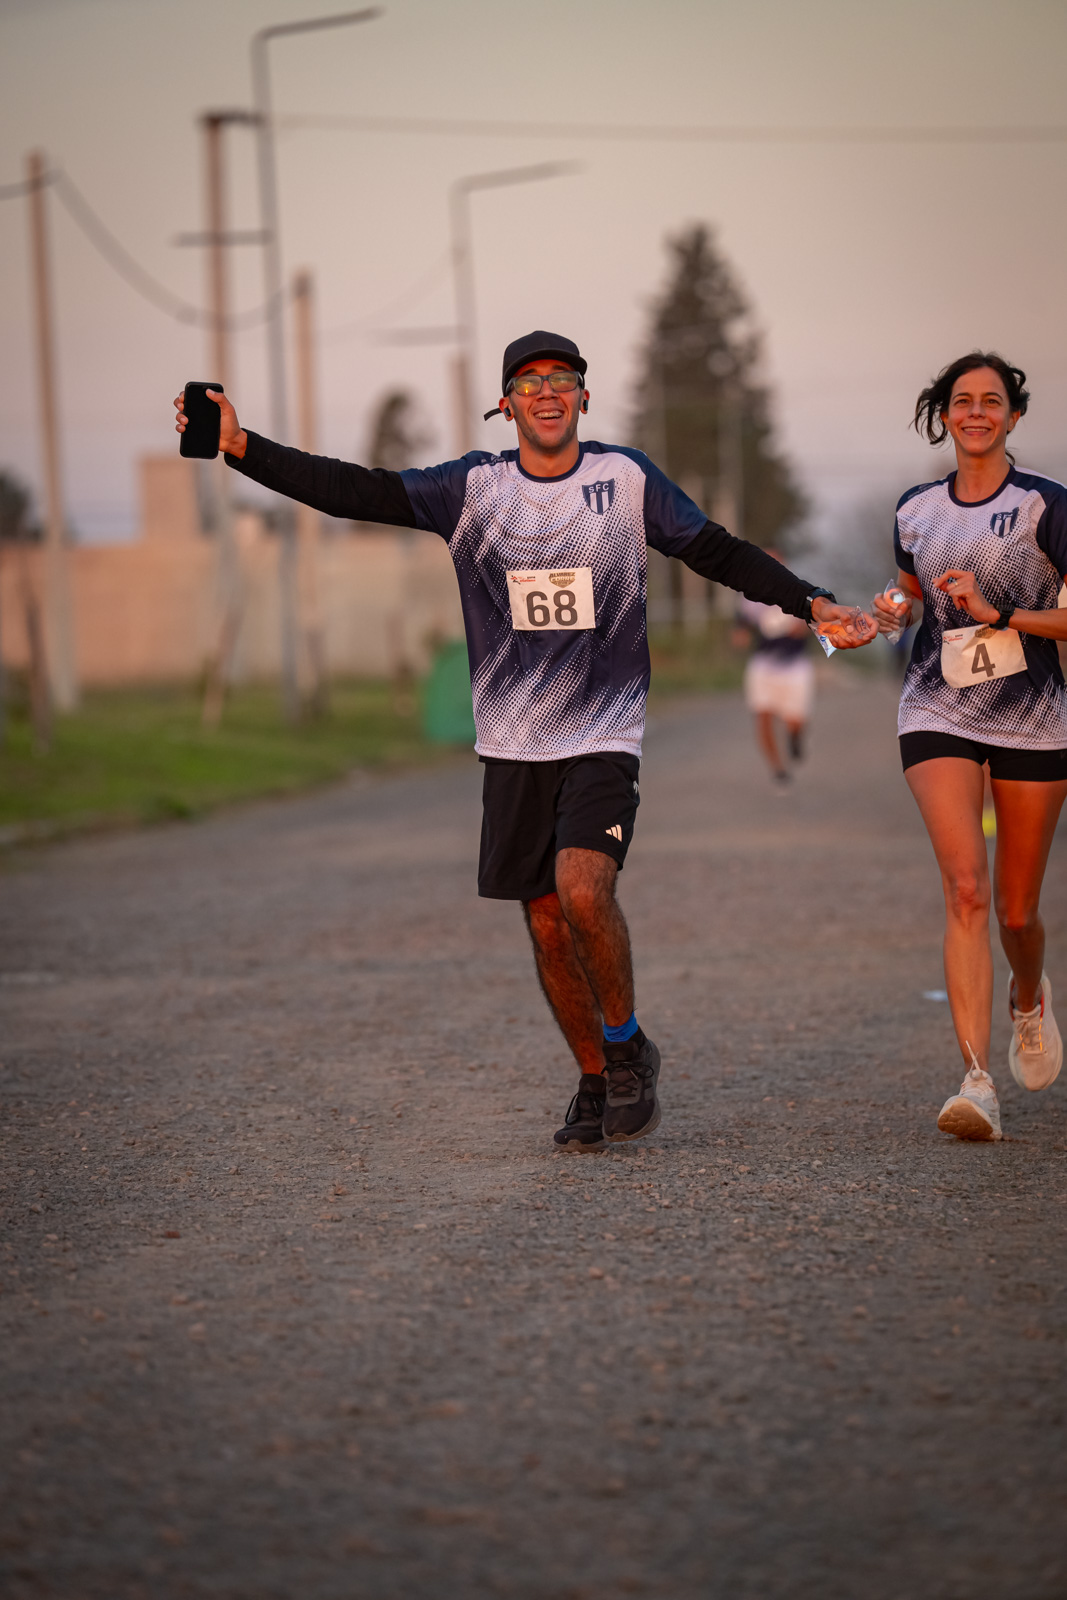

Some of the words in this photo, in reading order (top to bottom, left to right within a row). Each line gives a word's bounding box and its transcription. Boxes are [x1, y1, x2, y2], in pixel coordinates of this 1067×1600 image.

[588, 482, 610, 494] SFC
[526, 590, 578, 627] 68
[971, 642, 996, 678] 4
